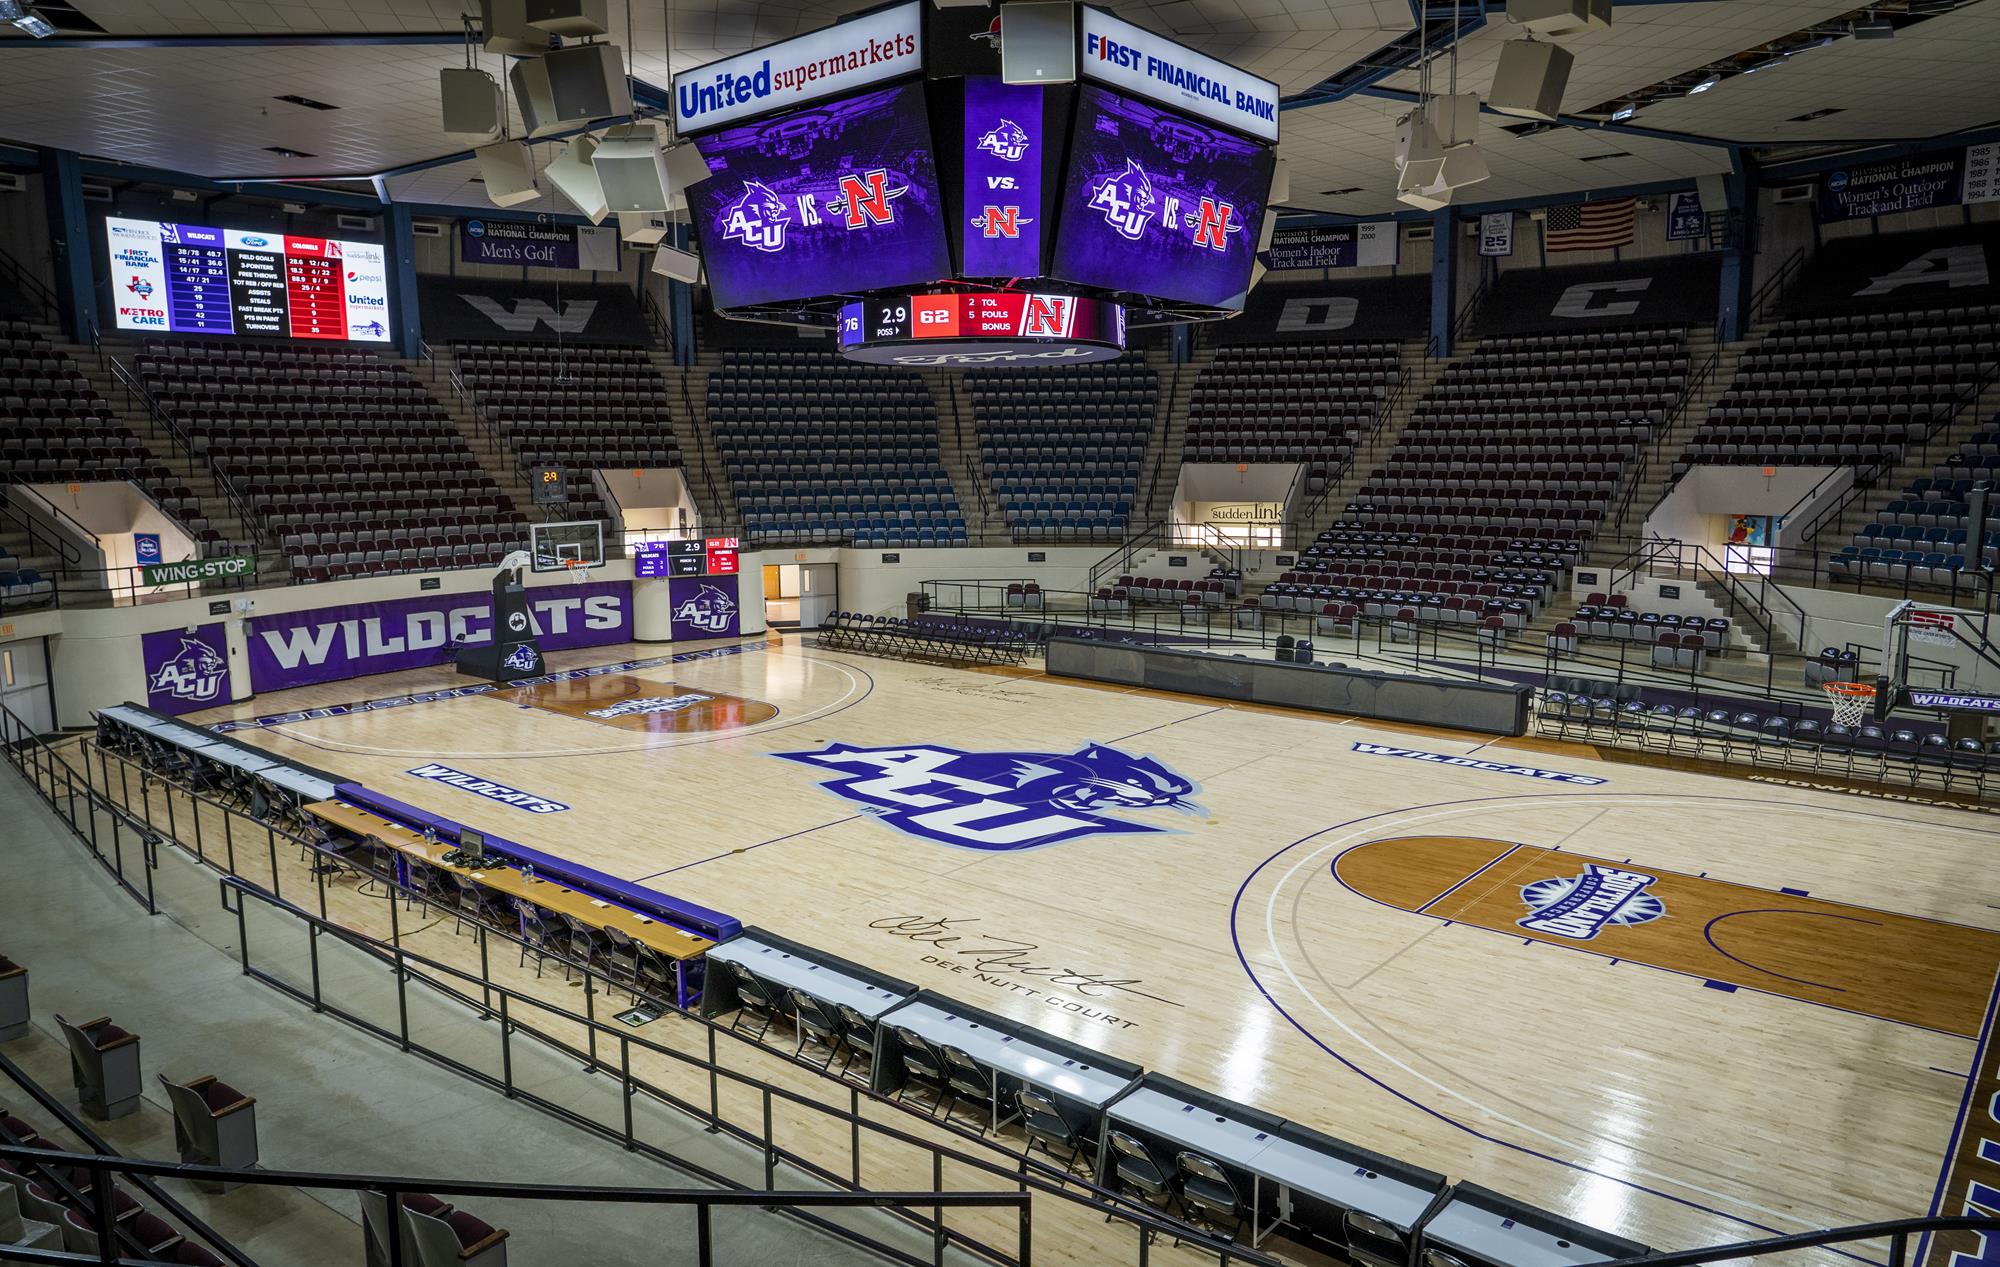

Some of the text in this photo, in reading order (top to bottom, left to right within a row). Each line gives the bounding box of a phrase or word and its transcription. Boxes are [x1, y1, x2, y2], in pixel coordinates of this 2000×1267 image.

[679, 33, 916, 119] United supermarkets
[1088, 32, 1274, 122] FIRST FINANCIAL BANK
[982, 133, 1021, 159] ACU
[1971, 147, 1991, 157] 1985
[1970, 158, 1990, 168] 1986
[1851, 161, 1954, 186] NATIONAL CHAMPION
[1852, 165, 1896, 175] DIVISION
[1969, 168, 1988, 178] 1987
[987, 177, 1019, 190] VS.
[1968, 179, 1987, 189] 1988
[1838, 179, 1947, 205] Women's Outdoor
[1967, 190, 1986, 200] 1994
[1099, 184, 1146, 234] ACU
[1163, 196, 1178, 230] VS.
[1847, 192, 1933, 217] Track and Field
[537, 213, 548, 224] G
[729, 210, 782, 248] ACU
[797, 194, 822, 227] VS.
[487, 222, 525, 231] DIVISION
[187, 232, 216, 241] WILDCATS
[246, 237, 264, 247] Ford
[487, 229, 570, 242] NATIONAL CHAMPION
[1274, 233, 1350, 245] NATIONAL CHAMPION
[1485, 235, 1507, 247] 25
[292, 242, 318, 251] COLONELS
[481, 242, 556, 261] Men's Golf
[1269, 245, 1341, 258] Women's Indoor
[114, 254, 159, 263] FINANCIAL
[238, 253, 275, 262] FIELD GOALS
[1271, 254, 1337, 268] Track and Field
[241, 262, 274, 271] 3-POINTERS
[1851, 243, 1990, 297] A
[254, 271, 278, 280] THROWS
[359, 274, 382, 284] pepsi
[349, 295, 384, 305] United
[968, 298, 975, 306] 2
[1550, 277, 1653, 318] C
[120, 307, 164, 317] METRO
[253, 306, 273, 314] BREAK
[456, 294, 599, 333] W
[882, 307, 906, 324] 2.9
[920, 309, 949, 324] 62
[968, 310, 1009, 319] 5 FOULS
[1276, 297, 1360, 332] D
[132, 316, 165, 325] CARE
[845, 317, 859, 332] 76
[981, 323, 1011, 331] BONUS
[877, 327, 893, 337] POSS
[892, 348, 1094, 366] Ford
[1212, 503, 1282, 519] suddenlink
[685, 542, 700, 551] 2.9
[679, 602, 729, 629] ACU
[506, 655, 535, 671] ACU
[158, 664, 218, 696] ACU
[1913, 695, 2000, 708] WILDCATS
[1356, 743, 1603, 785] WILDCATS
[410, 764, 566, 813] WILDCATS
[807, 750, 1106, 843] ACU
[1526, 866, 1652, 938] SOUTHLAND
[1541, 876, 1600, 919] CONFERENCE
[920, 954, 1140, 1030] DEE NUTT COURT
